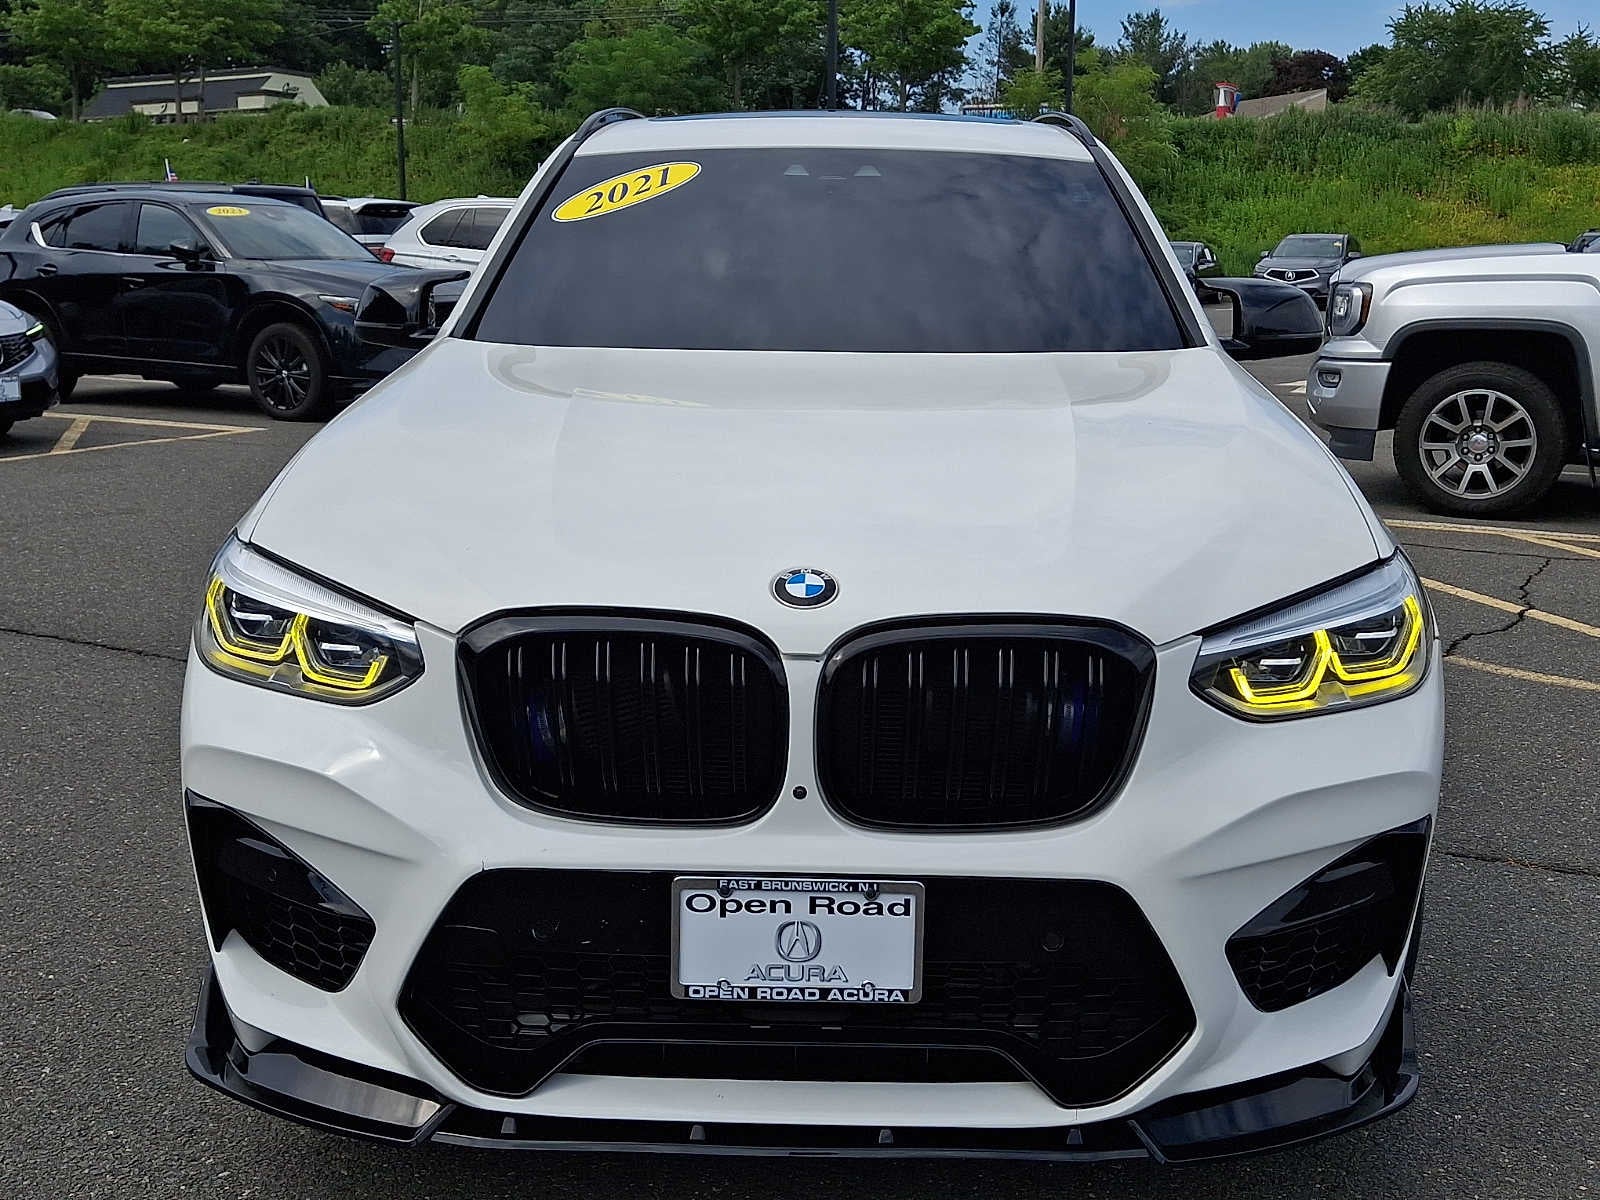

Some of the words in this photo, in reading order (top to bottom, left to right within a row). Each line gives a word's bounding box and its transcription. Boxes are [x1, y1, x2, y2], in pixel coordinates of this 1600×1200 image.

[584, 166, 671, 215] 2021
[761, 881, 853, 892] BRUNSWICK,
[685, 893, 792, 918] Open
[808, 895, 911, 917] Road
[744, 963, 849, 983] ACURA
[688, 986, 749, 1000] OPEN
[756, 987, 820, 1001] ROAD
[826, 988, 905, 1002] ACURA
